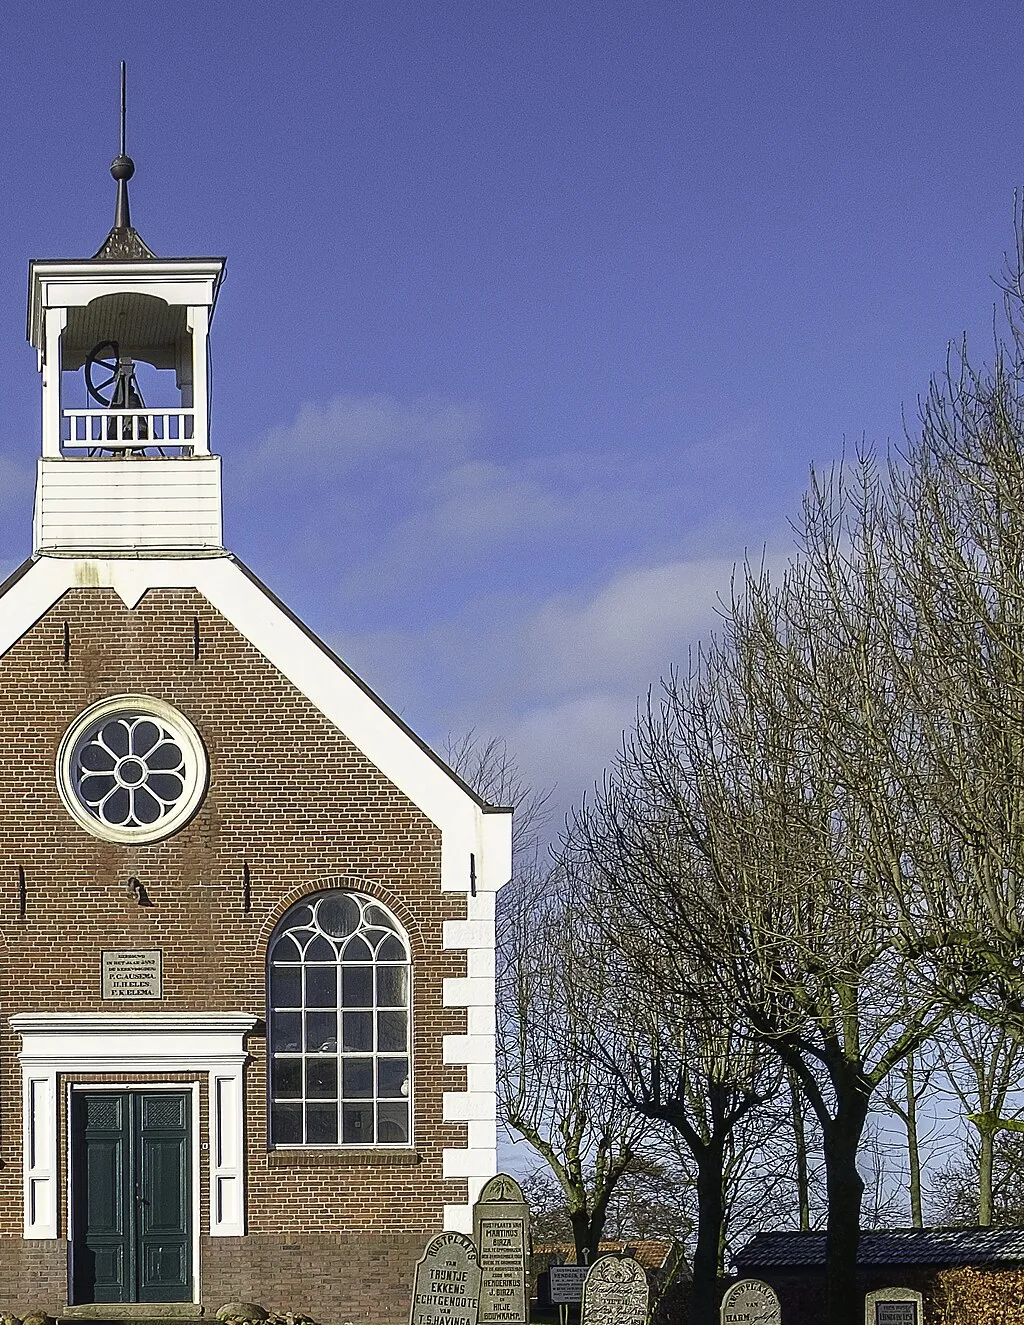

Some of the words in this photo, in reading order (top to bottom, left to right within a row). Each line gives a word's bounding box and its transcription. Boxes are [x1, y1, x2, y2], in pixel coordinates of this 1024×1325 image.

[486, 1230, 518, 1238] MARTINUS
[428, 1235, 476, 1260] RUSTPLAATS
[492, 1238, 512, 1246] BIRZA
[431, 1283, 465, 1294] EKKENS
[416, 1294, 478, 1308] ECHTGENOOTE
[728, 1283, 776, 1307] RUSTPLAATS
